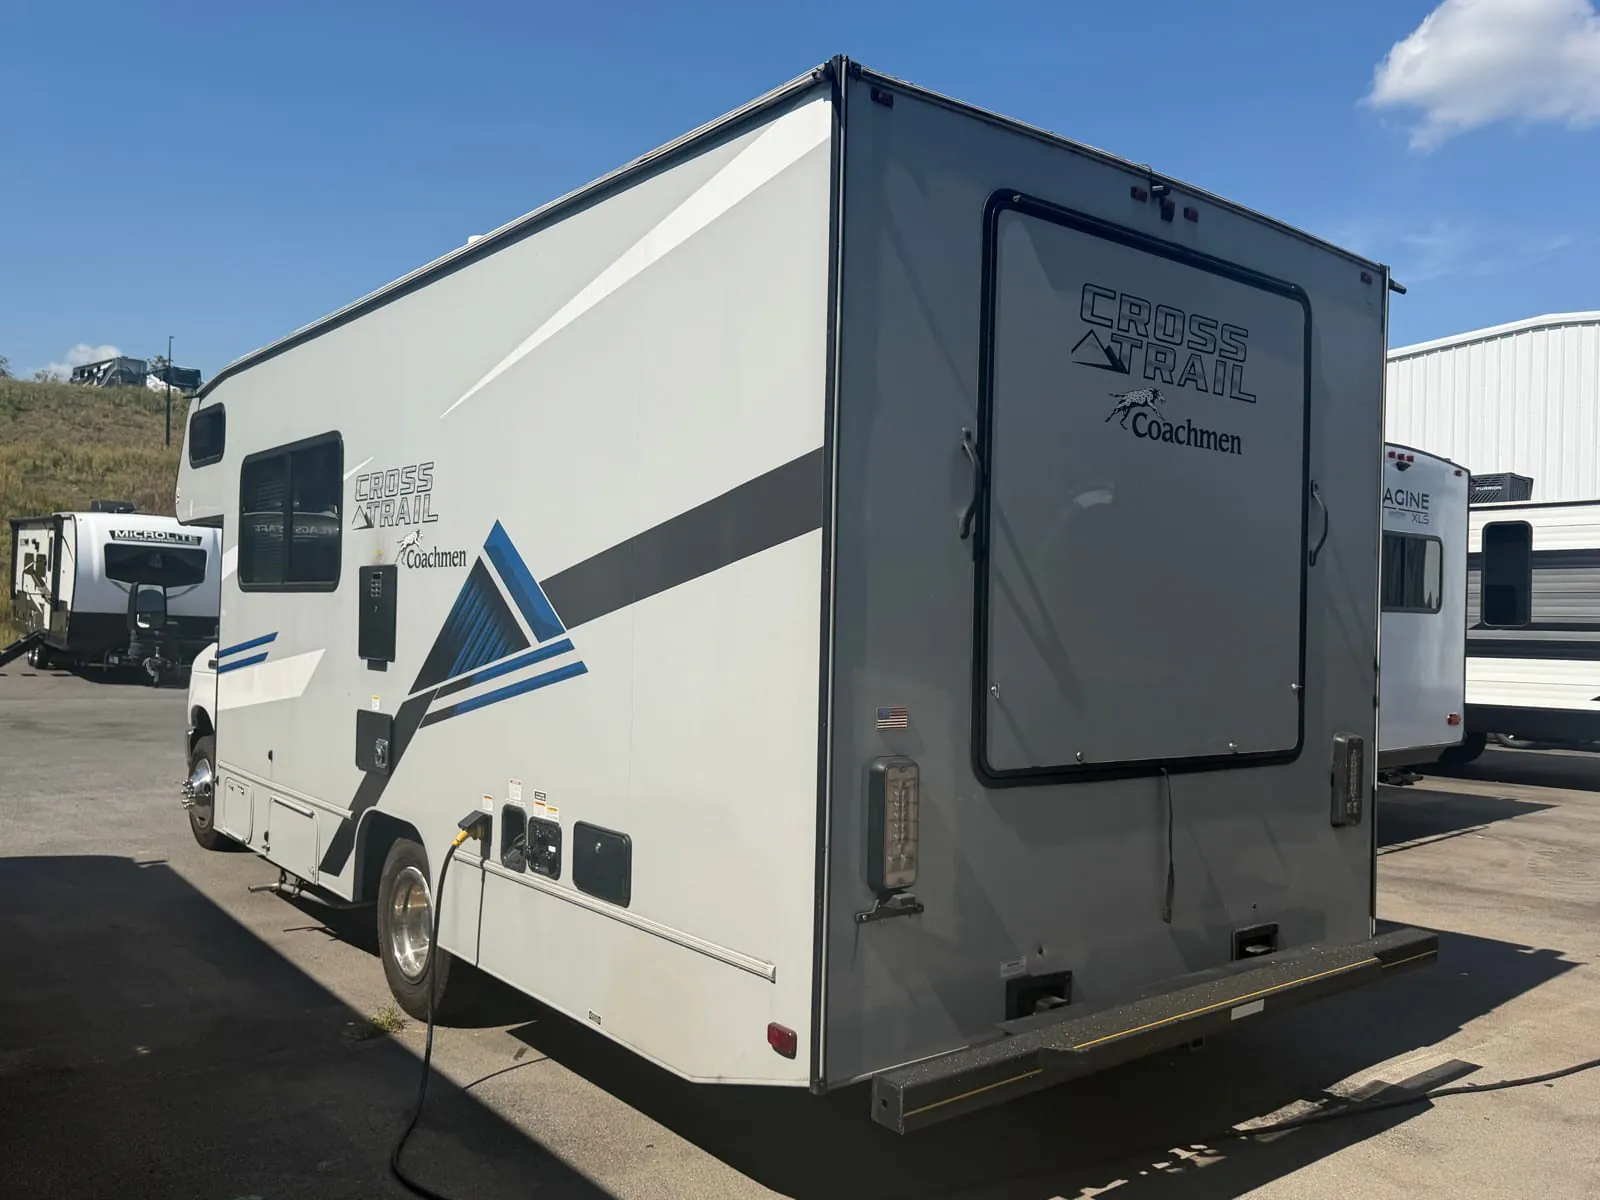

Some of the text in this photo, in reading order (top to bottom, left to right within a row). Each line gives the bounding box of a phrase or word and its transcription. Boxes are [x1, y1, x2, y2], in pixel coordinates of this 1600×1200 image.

[1080, 283, 1249, 363] CROSS
[1111, 333, 1257, 404] TRAIL
[1131, 412, 1242, 455] Coachmen
[355, 461, 435, 502] CROSS
[366, 493, 439, 528] TRAIL
[1411, 513, 1430, 525] XLS
[115, 531, 198, 542] MICROLITE
[406, 546, 467, 569] Coachmen
